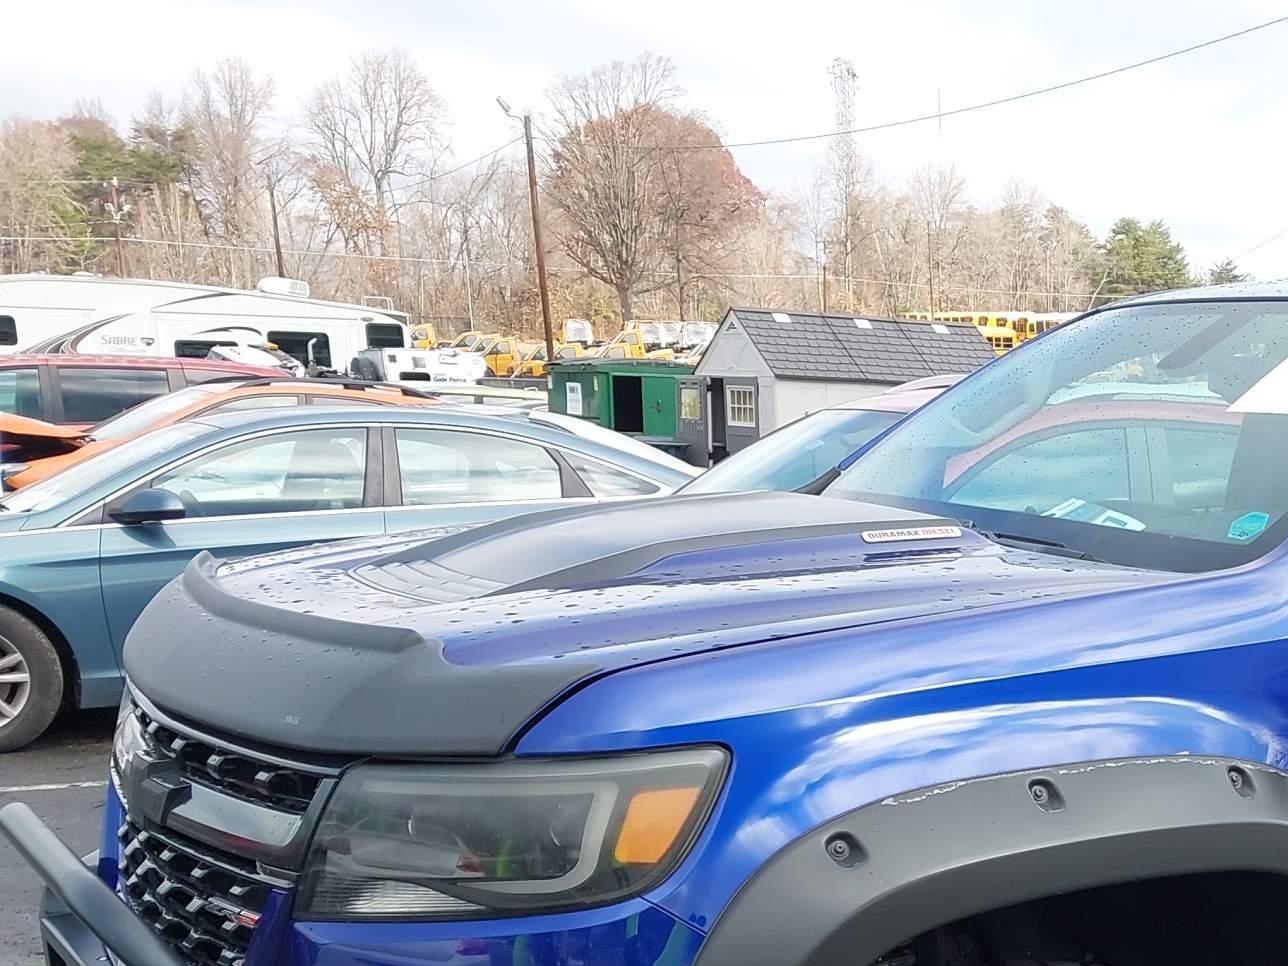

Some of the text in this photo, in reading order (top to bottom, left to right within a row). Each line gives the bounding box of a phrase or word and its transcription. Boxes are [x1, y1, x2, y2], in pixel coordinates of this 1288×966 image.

[100, 334, 138, 346] SABRE
[867, 527, 958, 540] DURAMAX DIESEL
